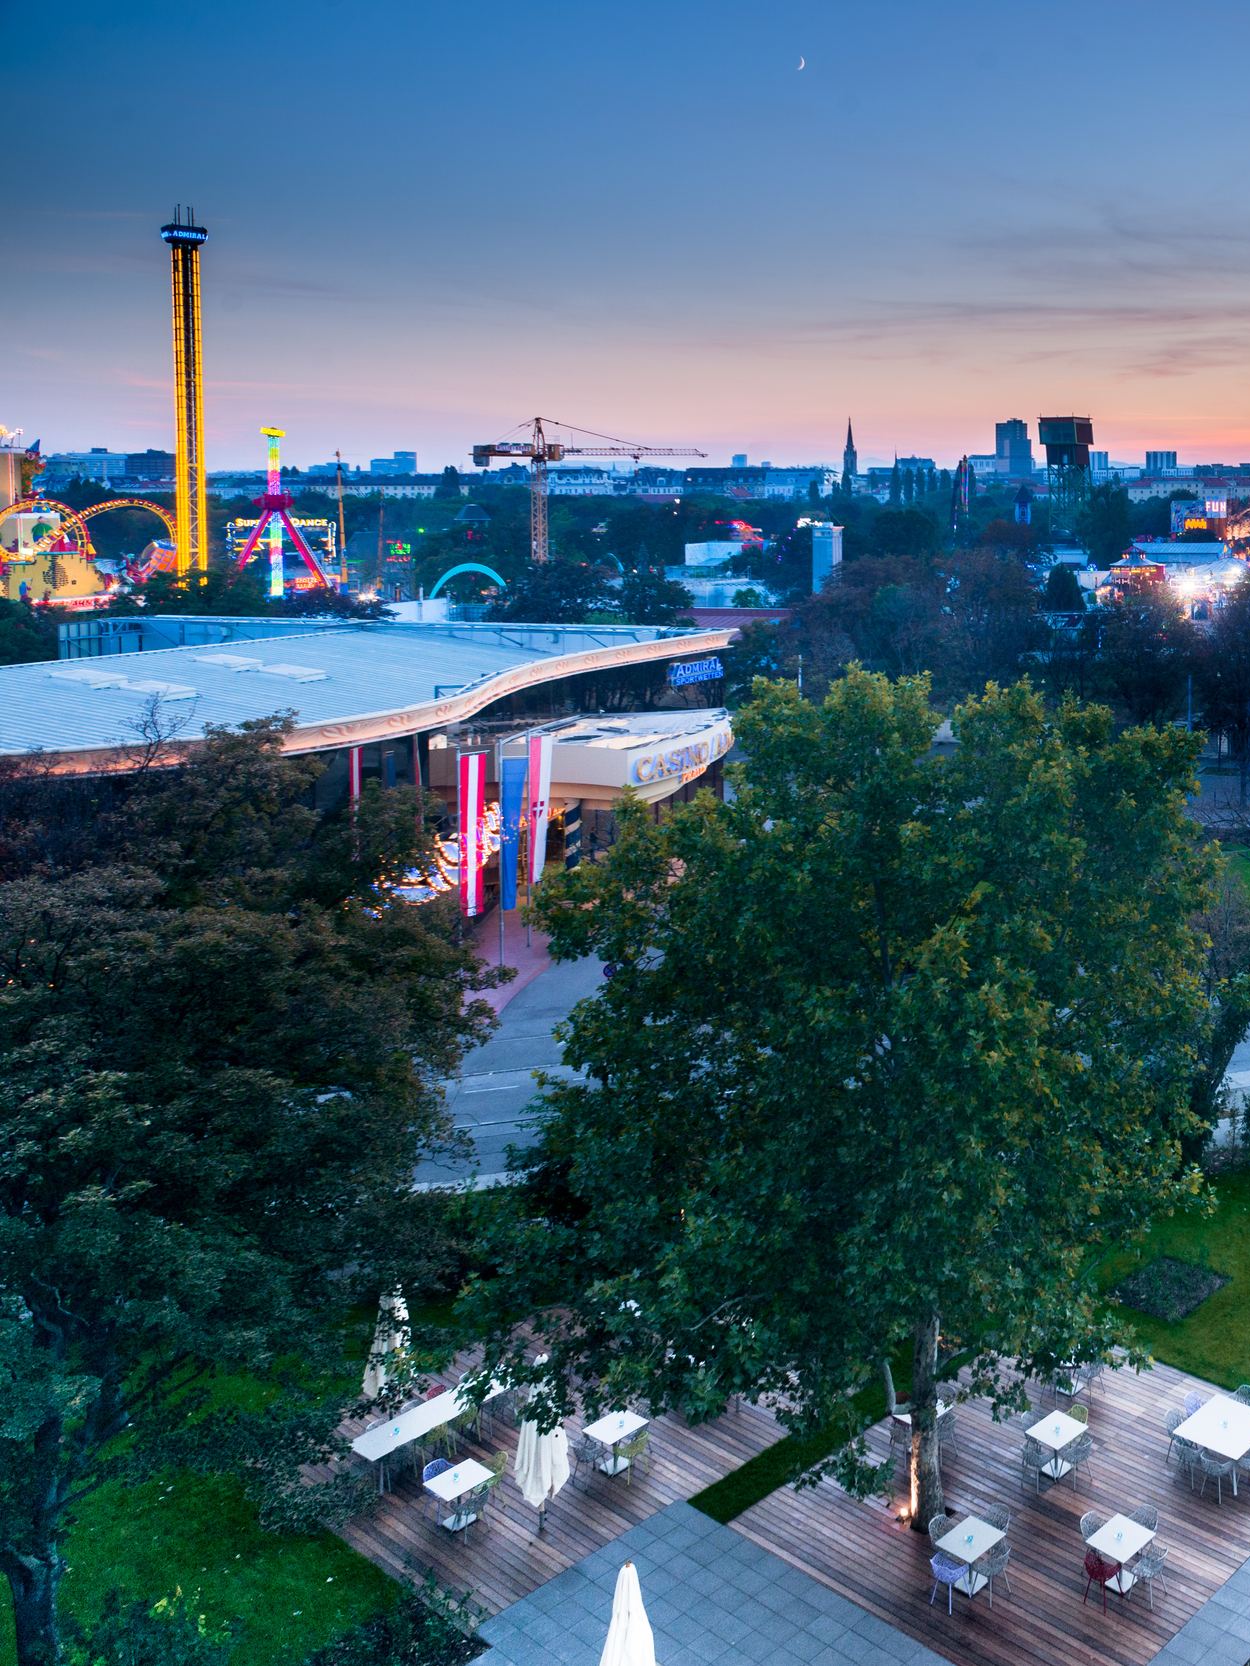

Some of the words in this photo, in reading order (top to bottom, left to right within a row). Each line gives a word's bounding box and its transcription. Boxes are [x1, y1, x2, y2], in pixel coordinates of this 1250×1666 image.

[172, 230, 206, 240] ADMIRAL
[1205, 501, 1226, 513] FUN
[290, 517, 328, 527] DANCE
[676, 657, 723, 677] ADMIRAL
[675, 671, 723, 686] SPORTWETTEN
[635, 741, 709, 783] CASINO
